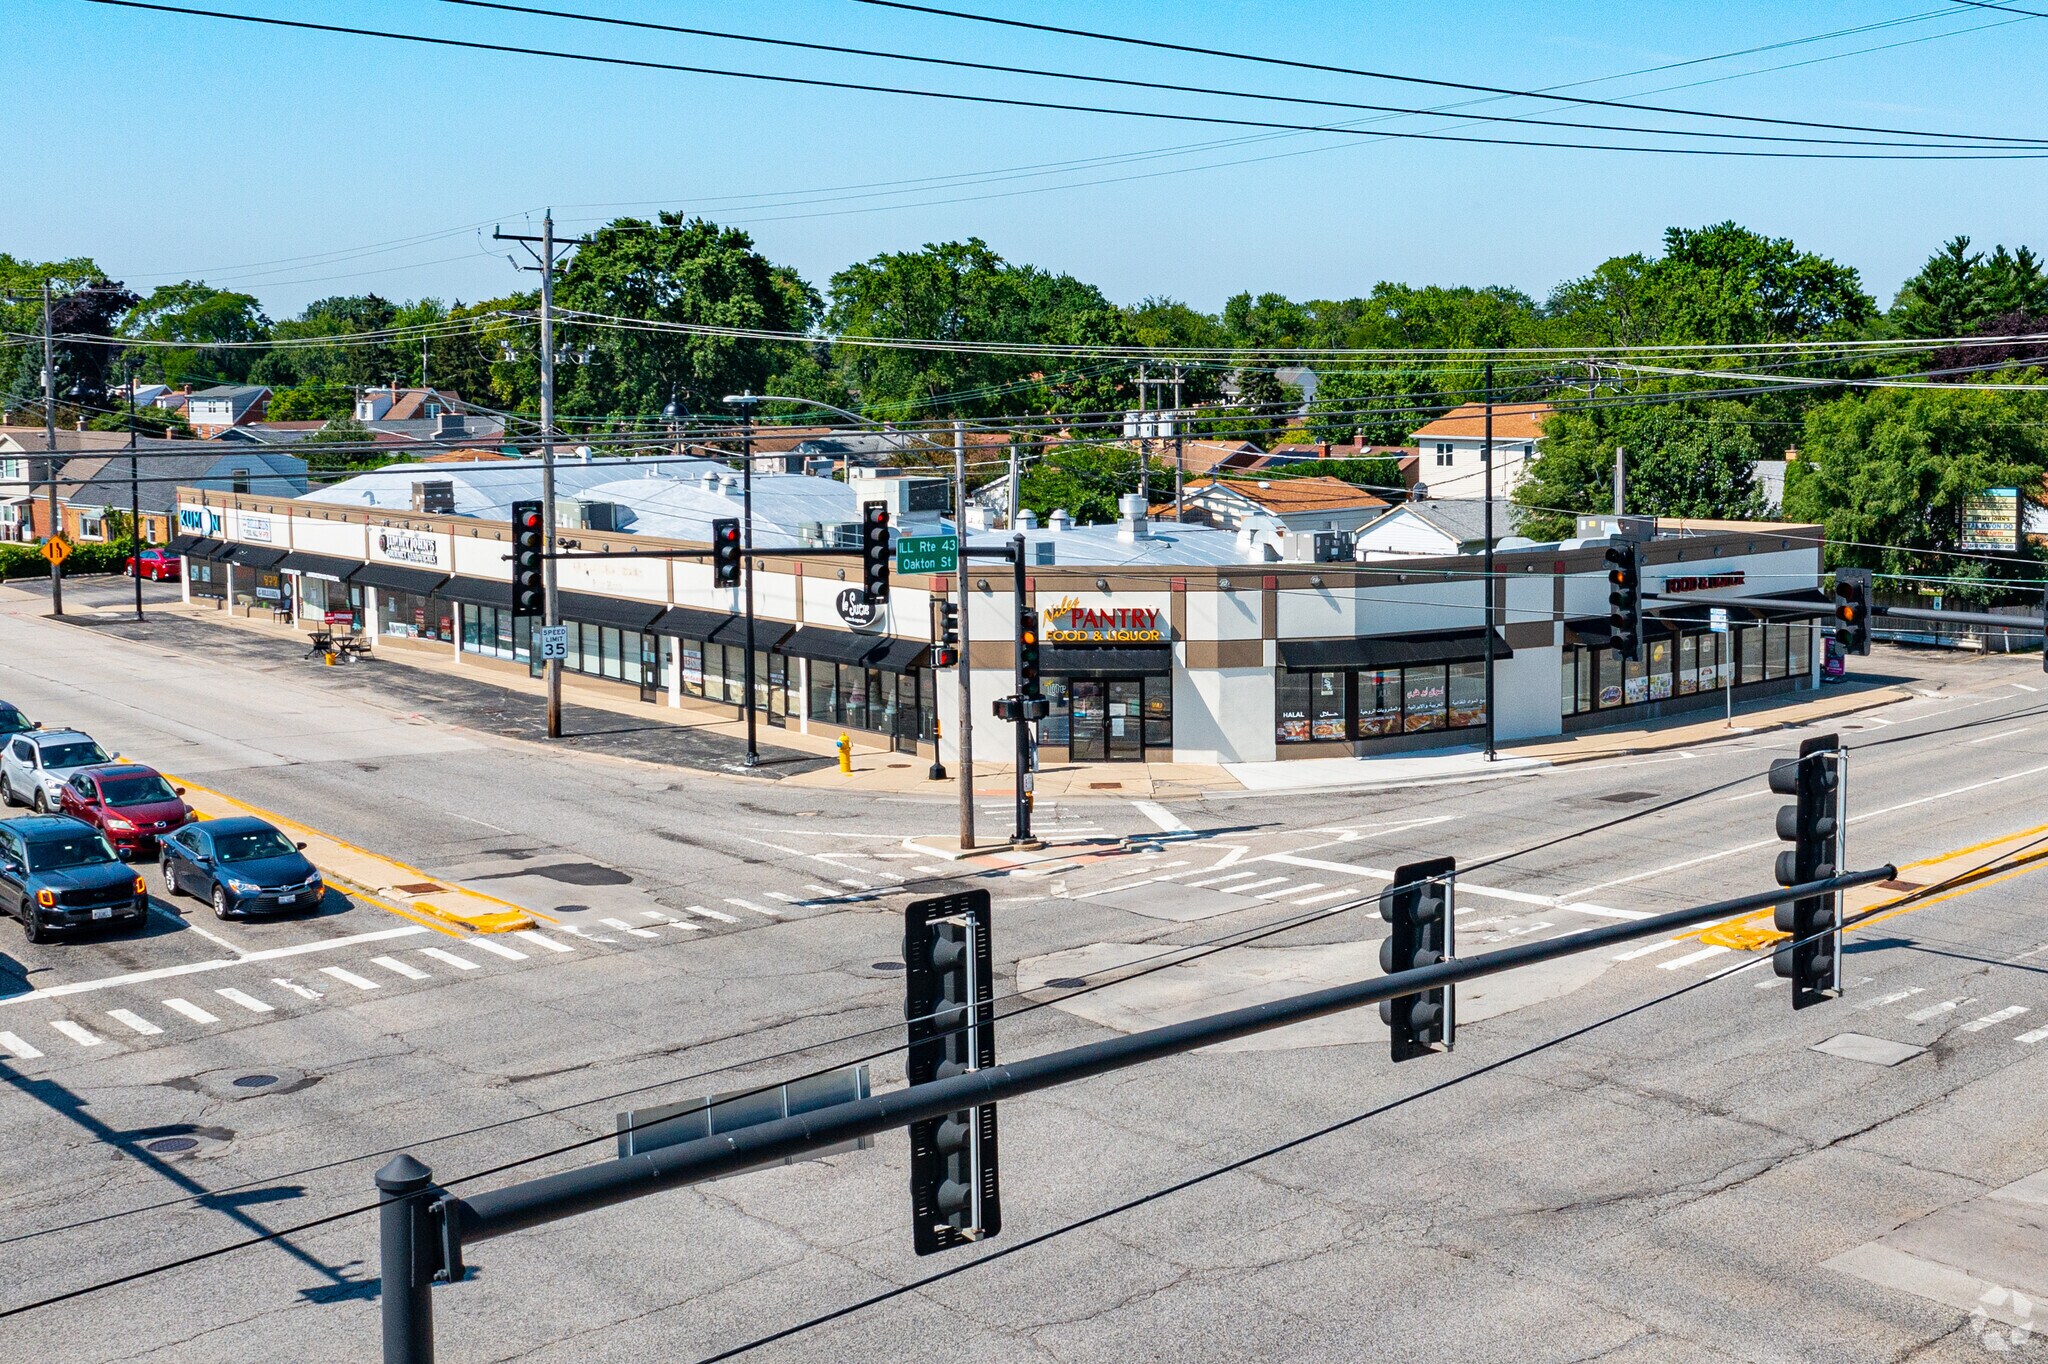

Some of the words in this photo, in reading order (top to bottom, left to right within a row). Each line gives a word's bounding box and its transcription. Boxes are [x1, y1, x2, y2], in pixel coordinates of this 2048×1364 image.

[180, 507, 221, 537] KUMON
[899, 542, 914, 553] ILL
[920, 541, 936, 552] Rte
[941, 540, 956, 551] 43
[903, 558, 935, 570] Oakton
[941, 557, 952, 568] St
[1042, 595, 1079, 628] Niles
[1071, 607, 1160, 629] PANTRY
[1046, 630, 1088, 641] FOOD
[1093, 630, 1102, 641] &
[1107, 630, 1160, 641] LIQUOR
[545, 643, 565, 656] 35
